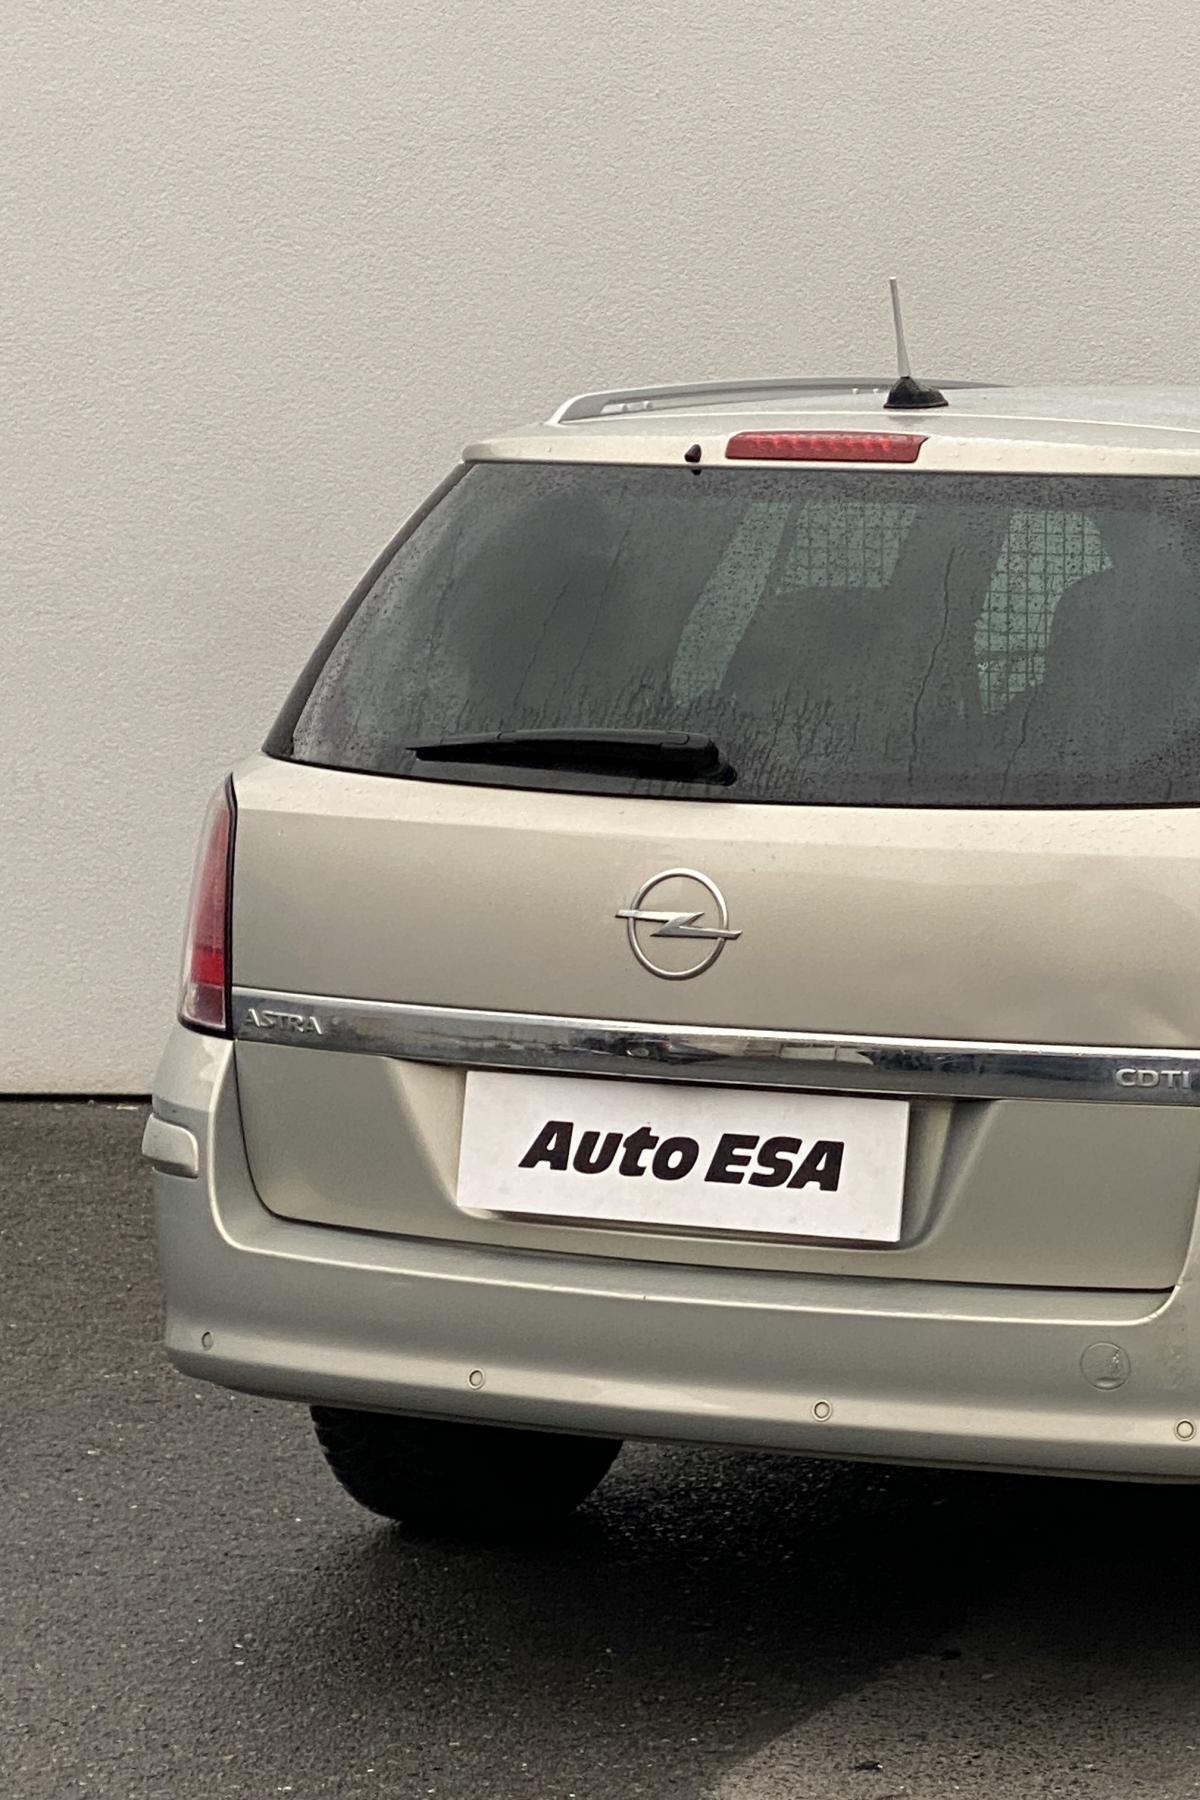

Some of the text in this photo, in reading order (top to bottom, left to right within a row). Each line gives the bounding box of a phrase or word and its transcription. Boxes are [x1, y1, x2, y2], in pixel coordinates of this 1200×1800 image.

[244, 1008, 323, 1035] ASTRA
[1115, 1068, 1190, 1089] CDTI
[518, 1119, 844, 1192] Auto ESA
